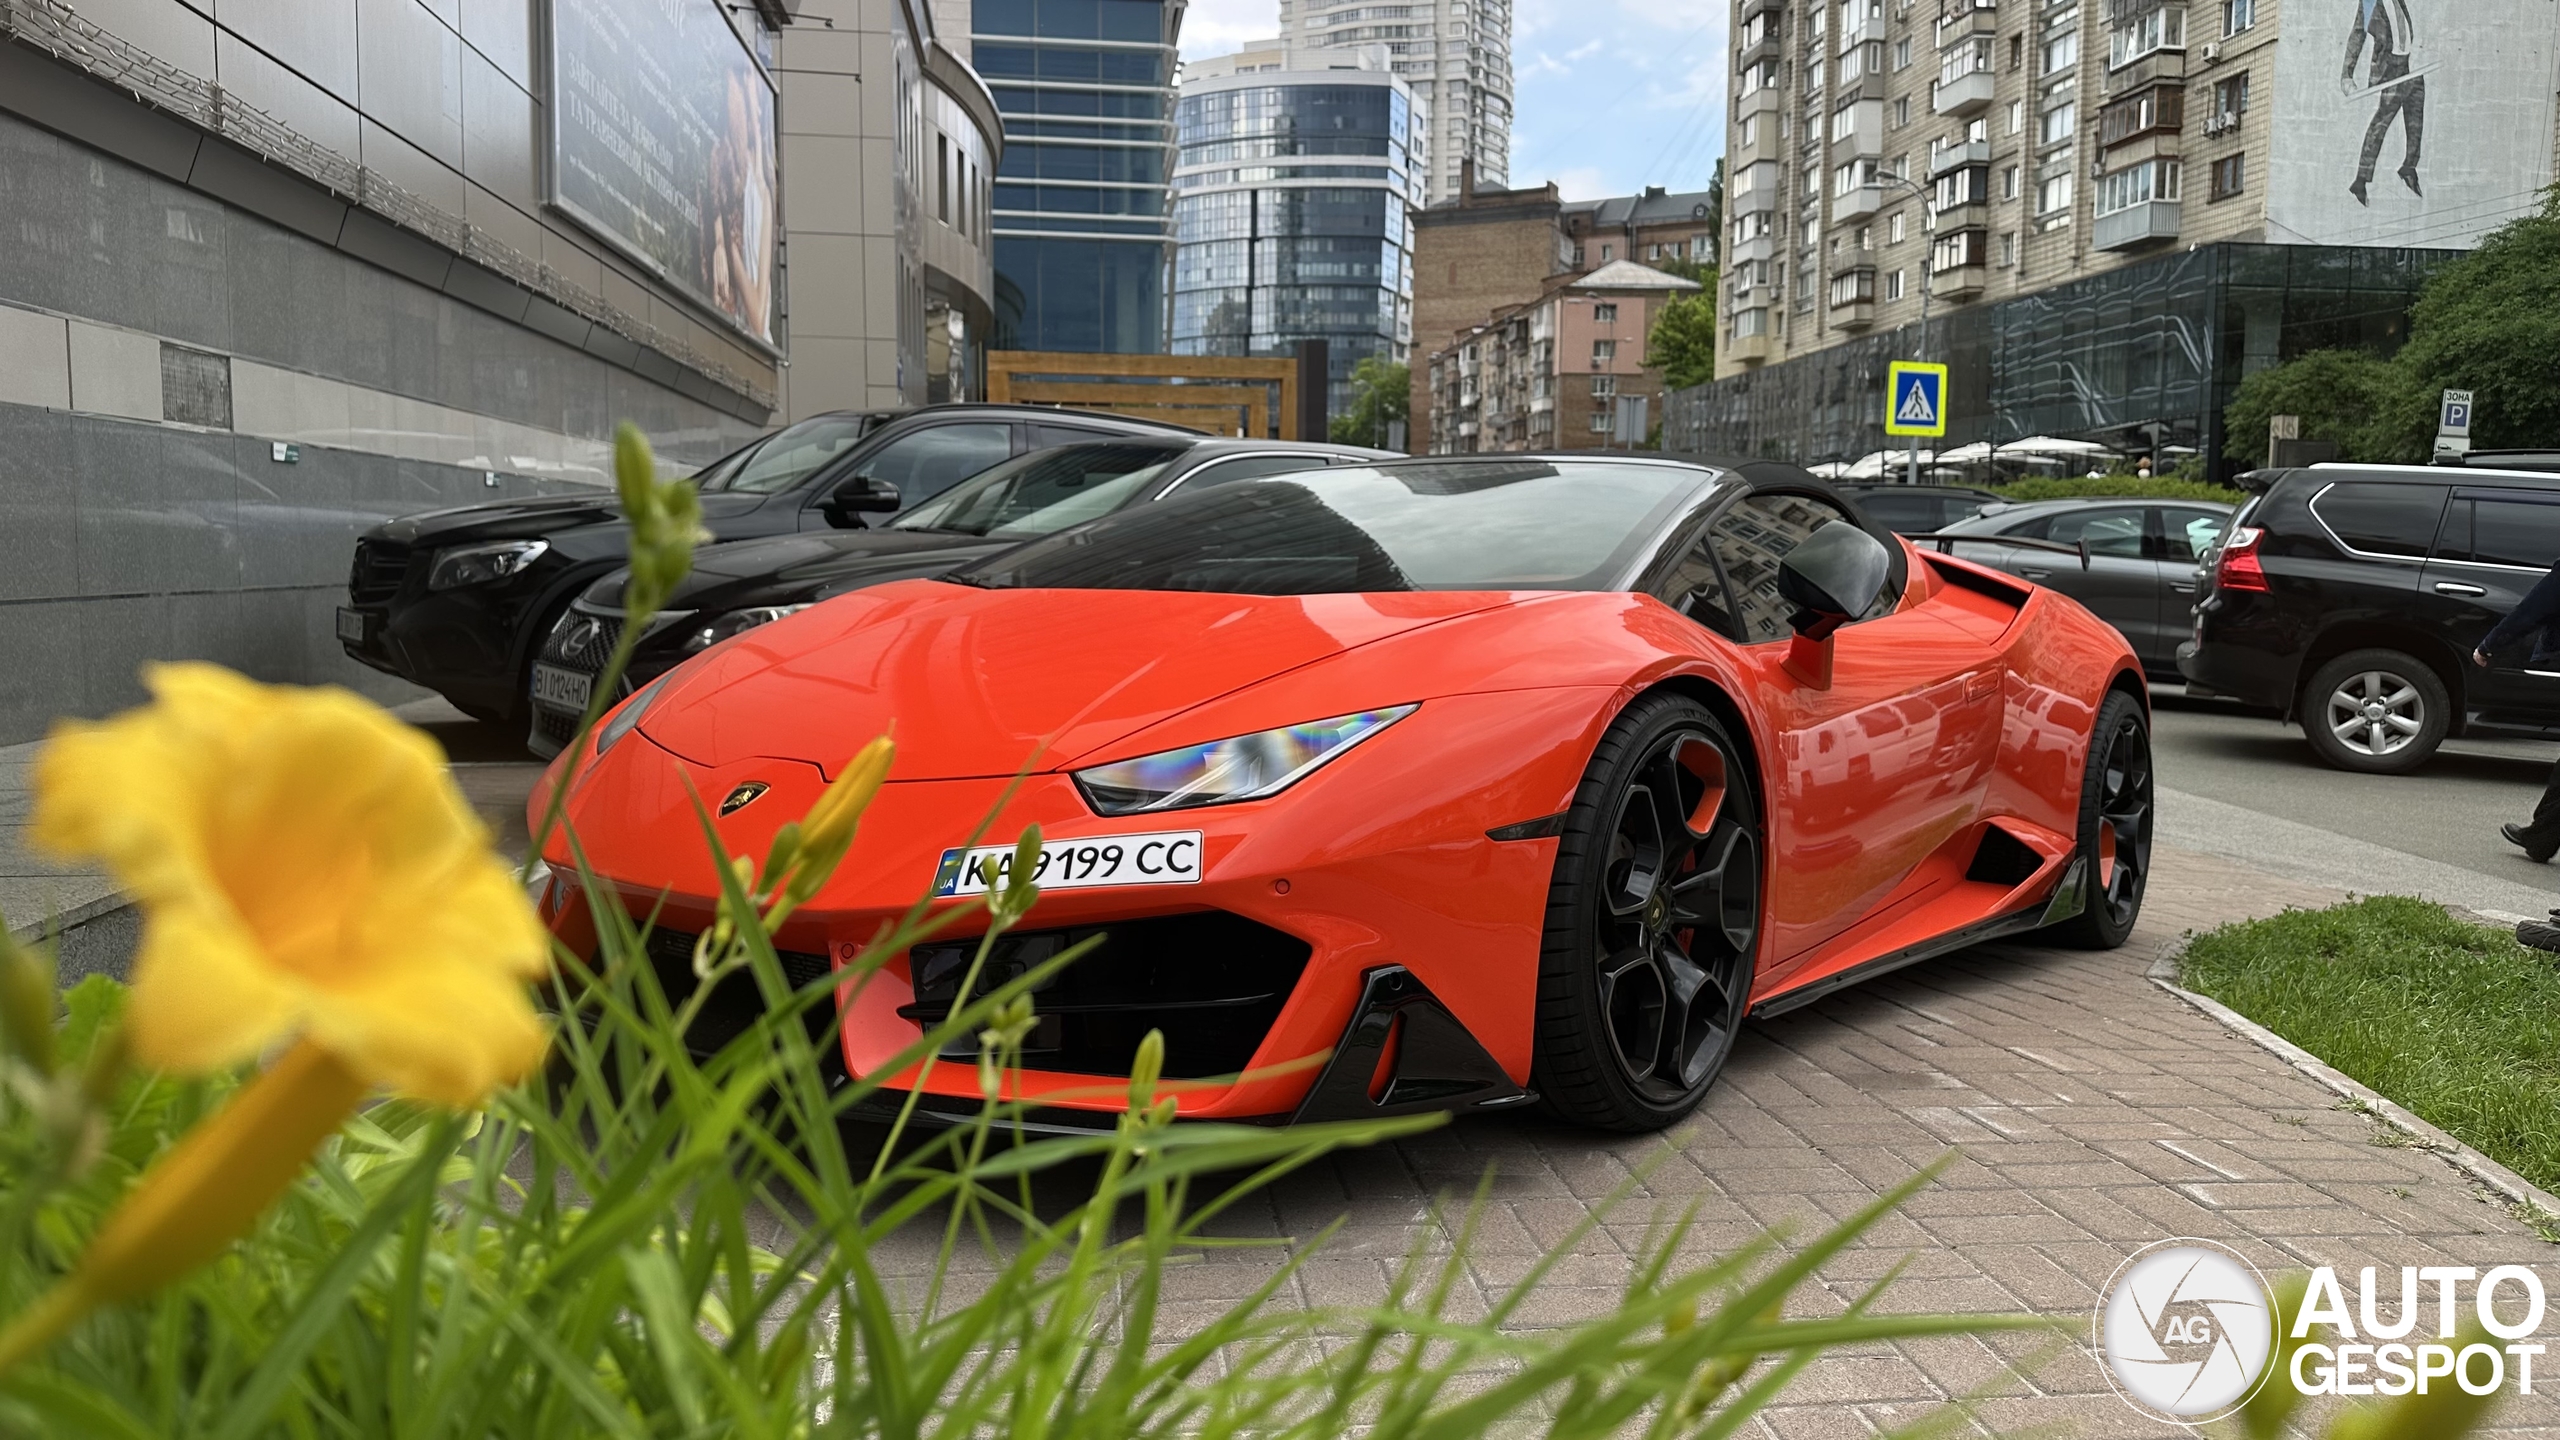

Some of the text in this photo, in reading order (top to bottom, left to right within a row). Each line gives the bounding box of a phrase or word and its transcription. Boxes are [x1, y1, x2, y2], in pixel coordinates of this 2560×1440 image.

[568, 51, 619, 123] ЗАВІТАЙТЕ
[620, 103, 631, 133] ЗА
[568, 89, 584, 125] ТА
[2446, 392, 2470, 402] ЗОНА
[1135, 839, 1195, 875] CC
